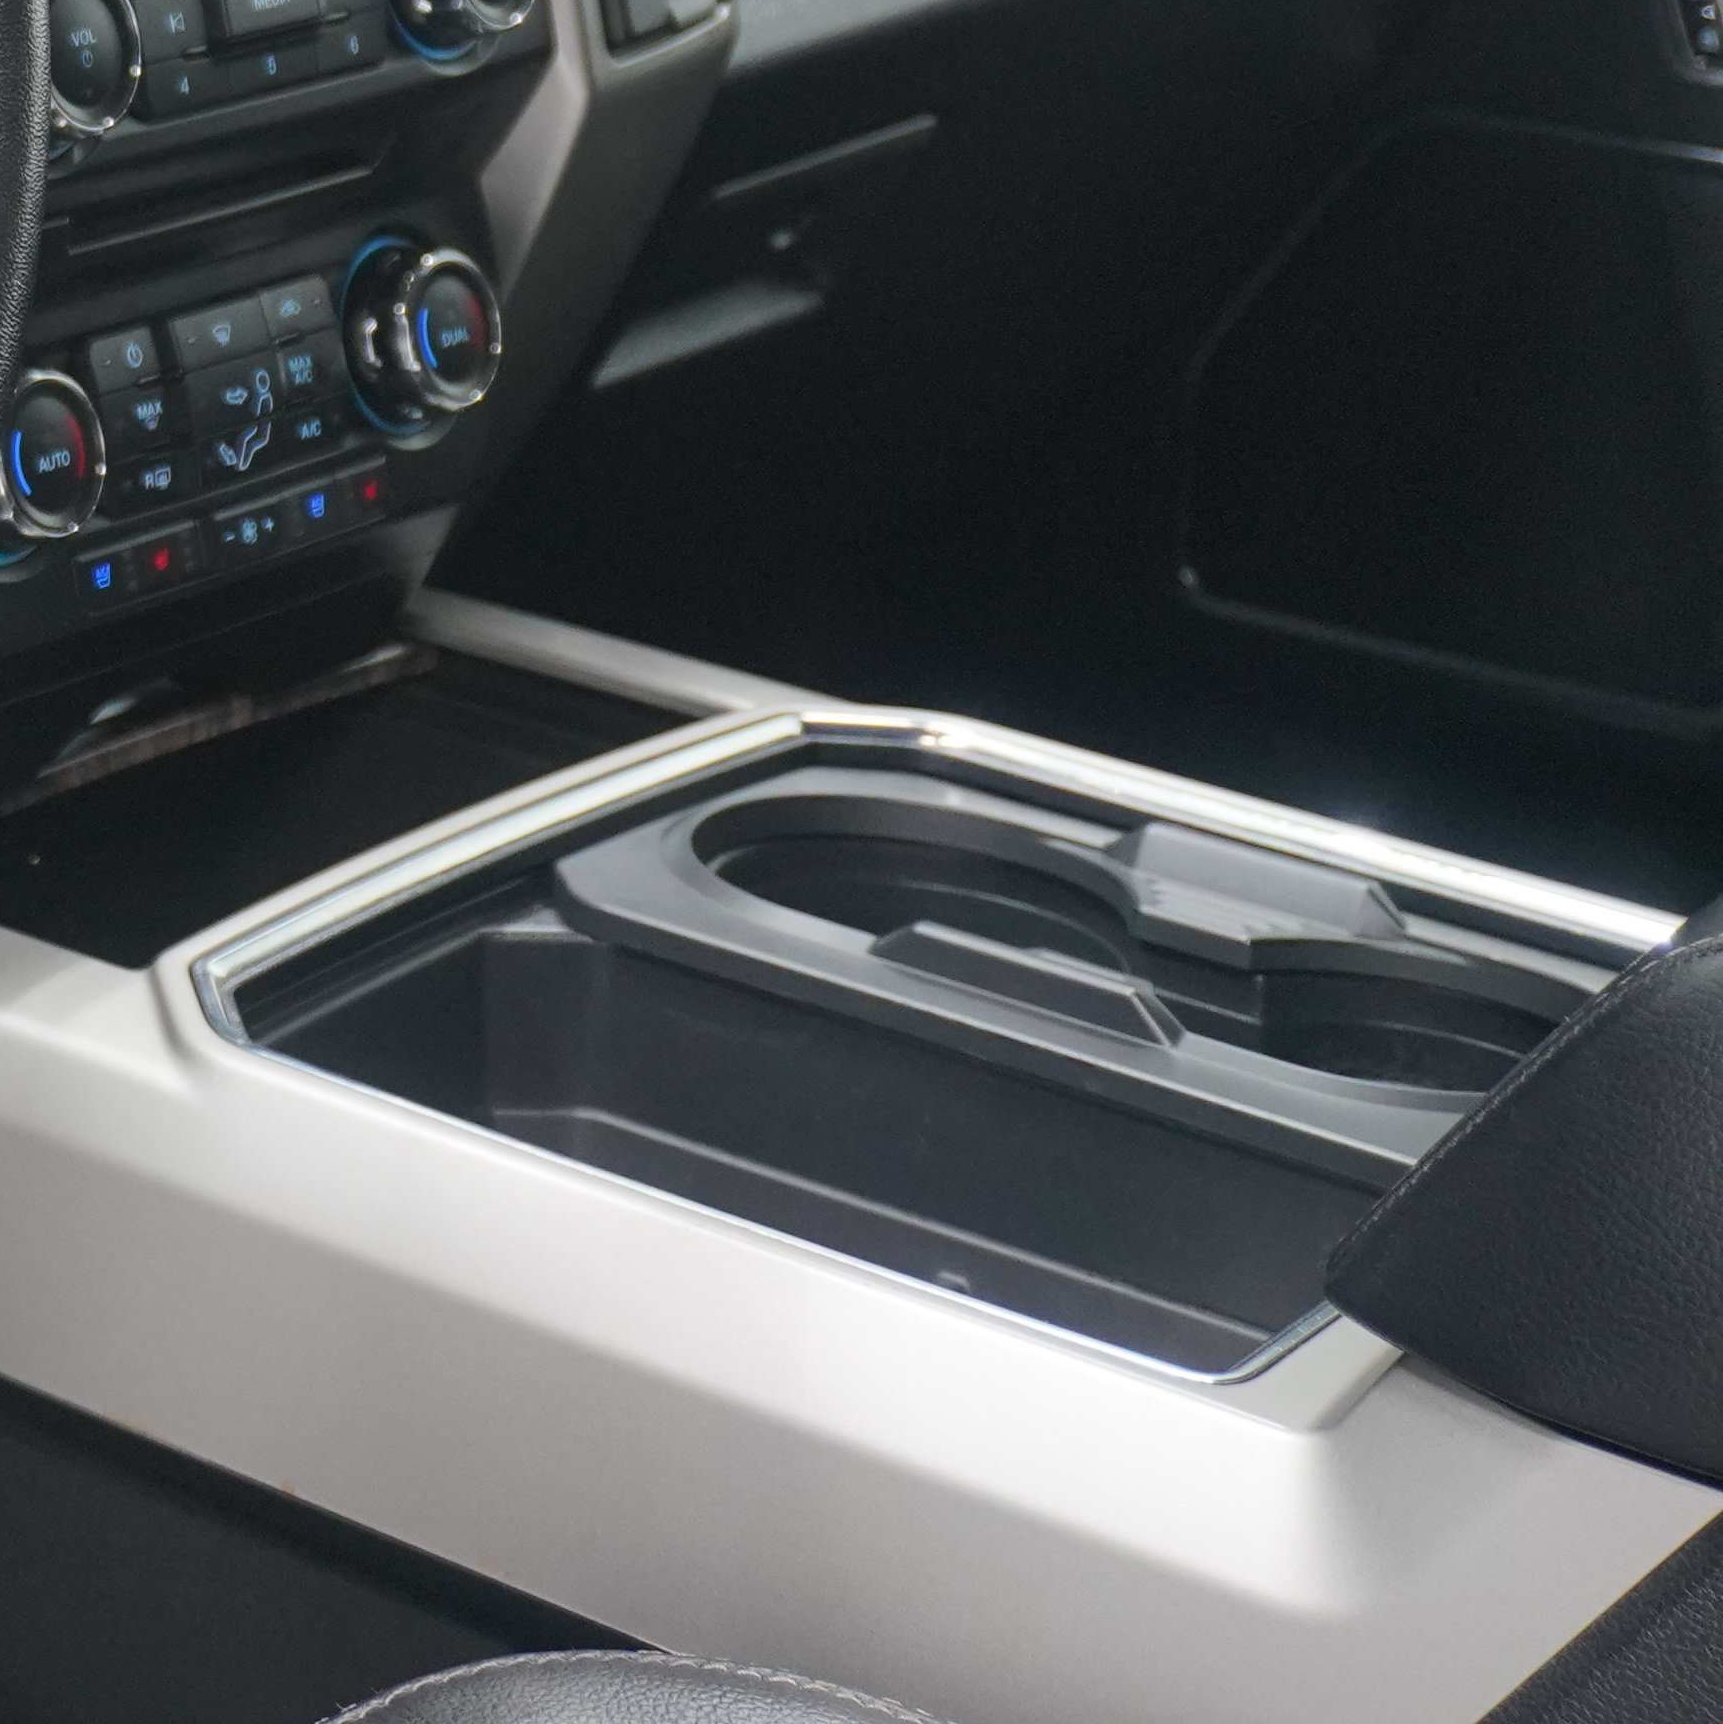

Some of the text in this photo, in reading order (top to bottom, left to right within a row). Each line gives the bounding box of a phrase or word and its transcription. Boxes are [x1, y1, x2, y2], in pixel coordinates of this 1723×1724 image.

[70, 28, 97, 47] VOL
[350, 36, 359, 55] 6
[266, 55, 277, 75] 5
[179, 77, 190, 94] 4
[441, 326, 469, 348] DUAL
[288, 354, 312, 373] MAX
[136, 400, 163, 421] MAX
[299, 418, 322, 439] A/C
[38, 449, 71, 474] AUTO
